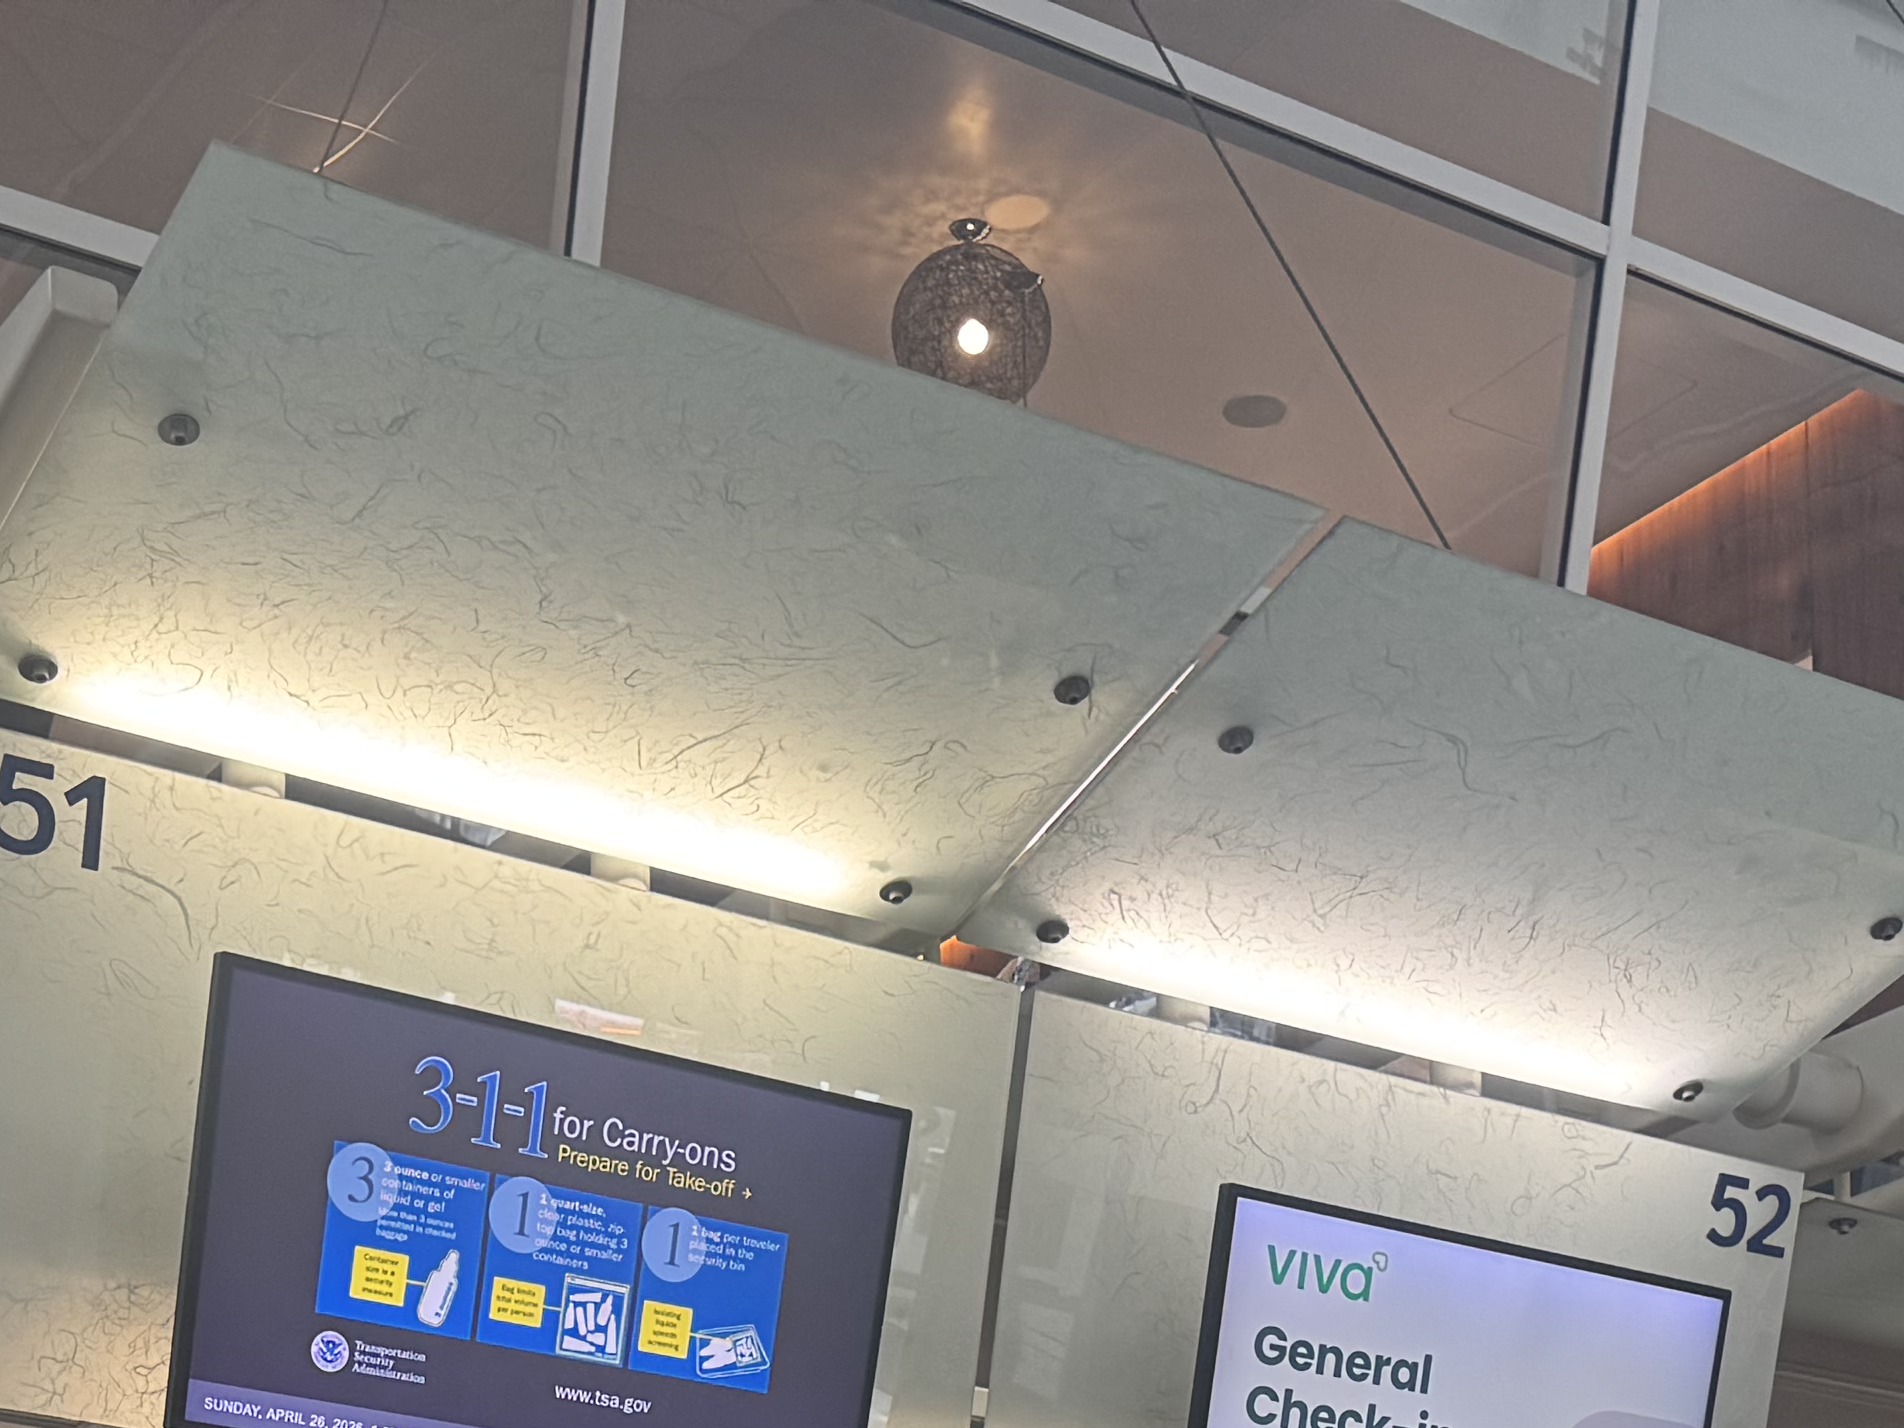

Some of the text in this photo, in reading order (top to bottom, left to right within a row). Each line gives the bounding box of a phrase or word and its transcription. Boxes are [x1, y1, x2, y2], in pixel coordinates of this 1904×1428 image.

[409, 1056, 737, 1173] 3-1-1 for Carry-ons
[347, 1156, 375, 1203] 3
[383, 1160, 486, 1191] 3 ounce or smaller
[558, 1144, 736, 1200] Prepare for Take-off
[380, 1190, 445, 1213] liquid or gel
[381, 1177, 455, 1200] containers of
[539, 1193, 547, 1205] 1
[513, 1191, 530, 1238] 1
[538, 1208, 564, 1222] clear
[1705, 1172, 1792, 1258] 52
[537, 1223, 628, 1249] top bag holding 3
[663, 1222, 680, 1267] 1
[691, 1225, 780, 1251] 1 bag per traveler
[533, 1251, 588, 1269] containers
[534, 1239, 623, 1262] ounce or smaller
[688, 1252, 745, 1271] security bin
[689, 1239, 754, 1260] placed in the
[354, 1352, 394, 1369] Security
[355, 1340, 426, 1362] Transportation
[1254, 1325, 1433, 1394] General
[352, 1363, 426, 1384] Administration
[204, 1397, 262, 1419] SUNDAY,
[266, 1408, 306, 1425] APRIL
[554, 1385, 651, 1414] www.tsa.gov
